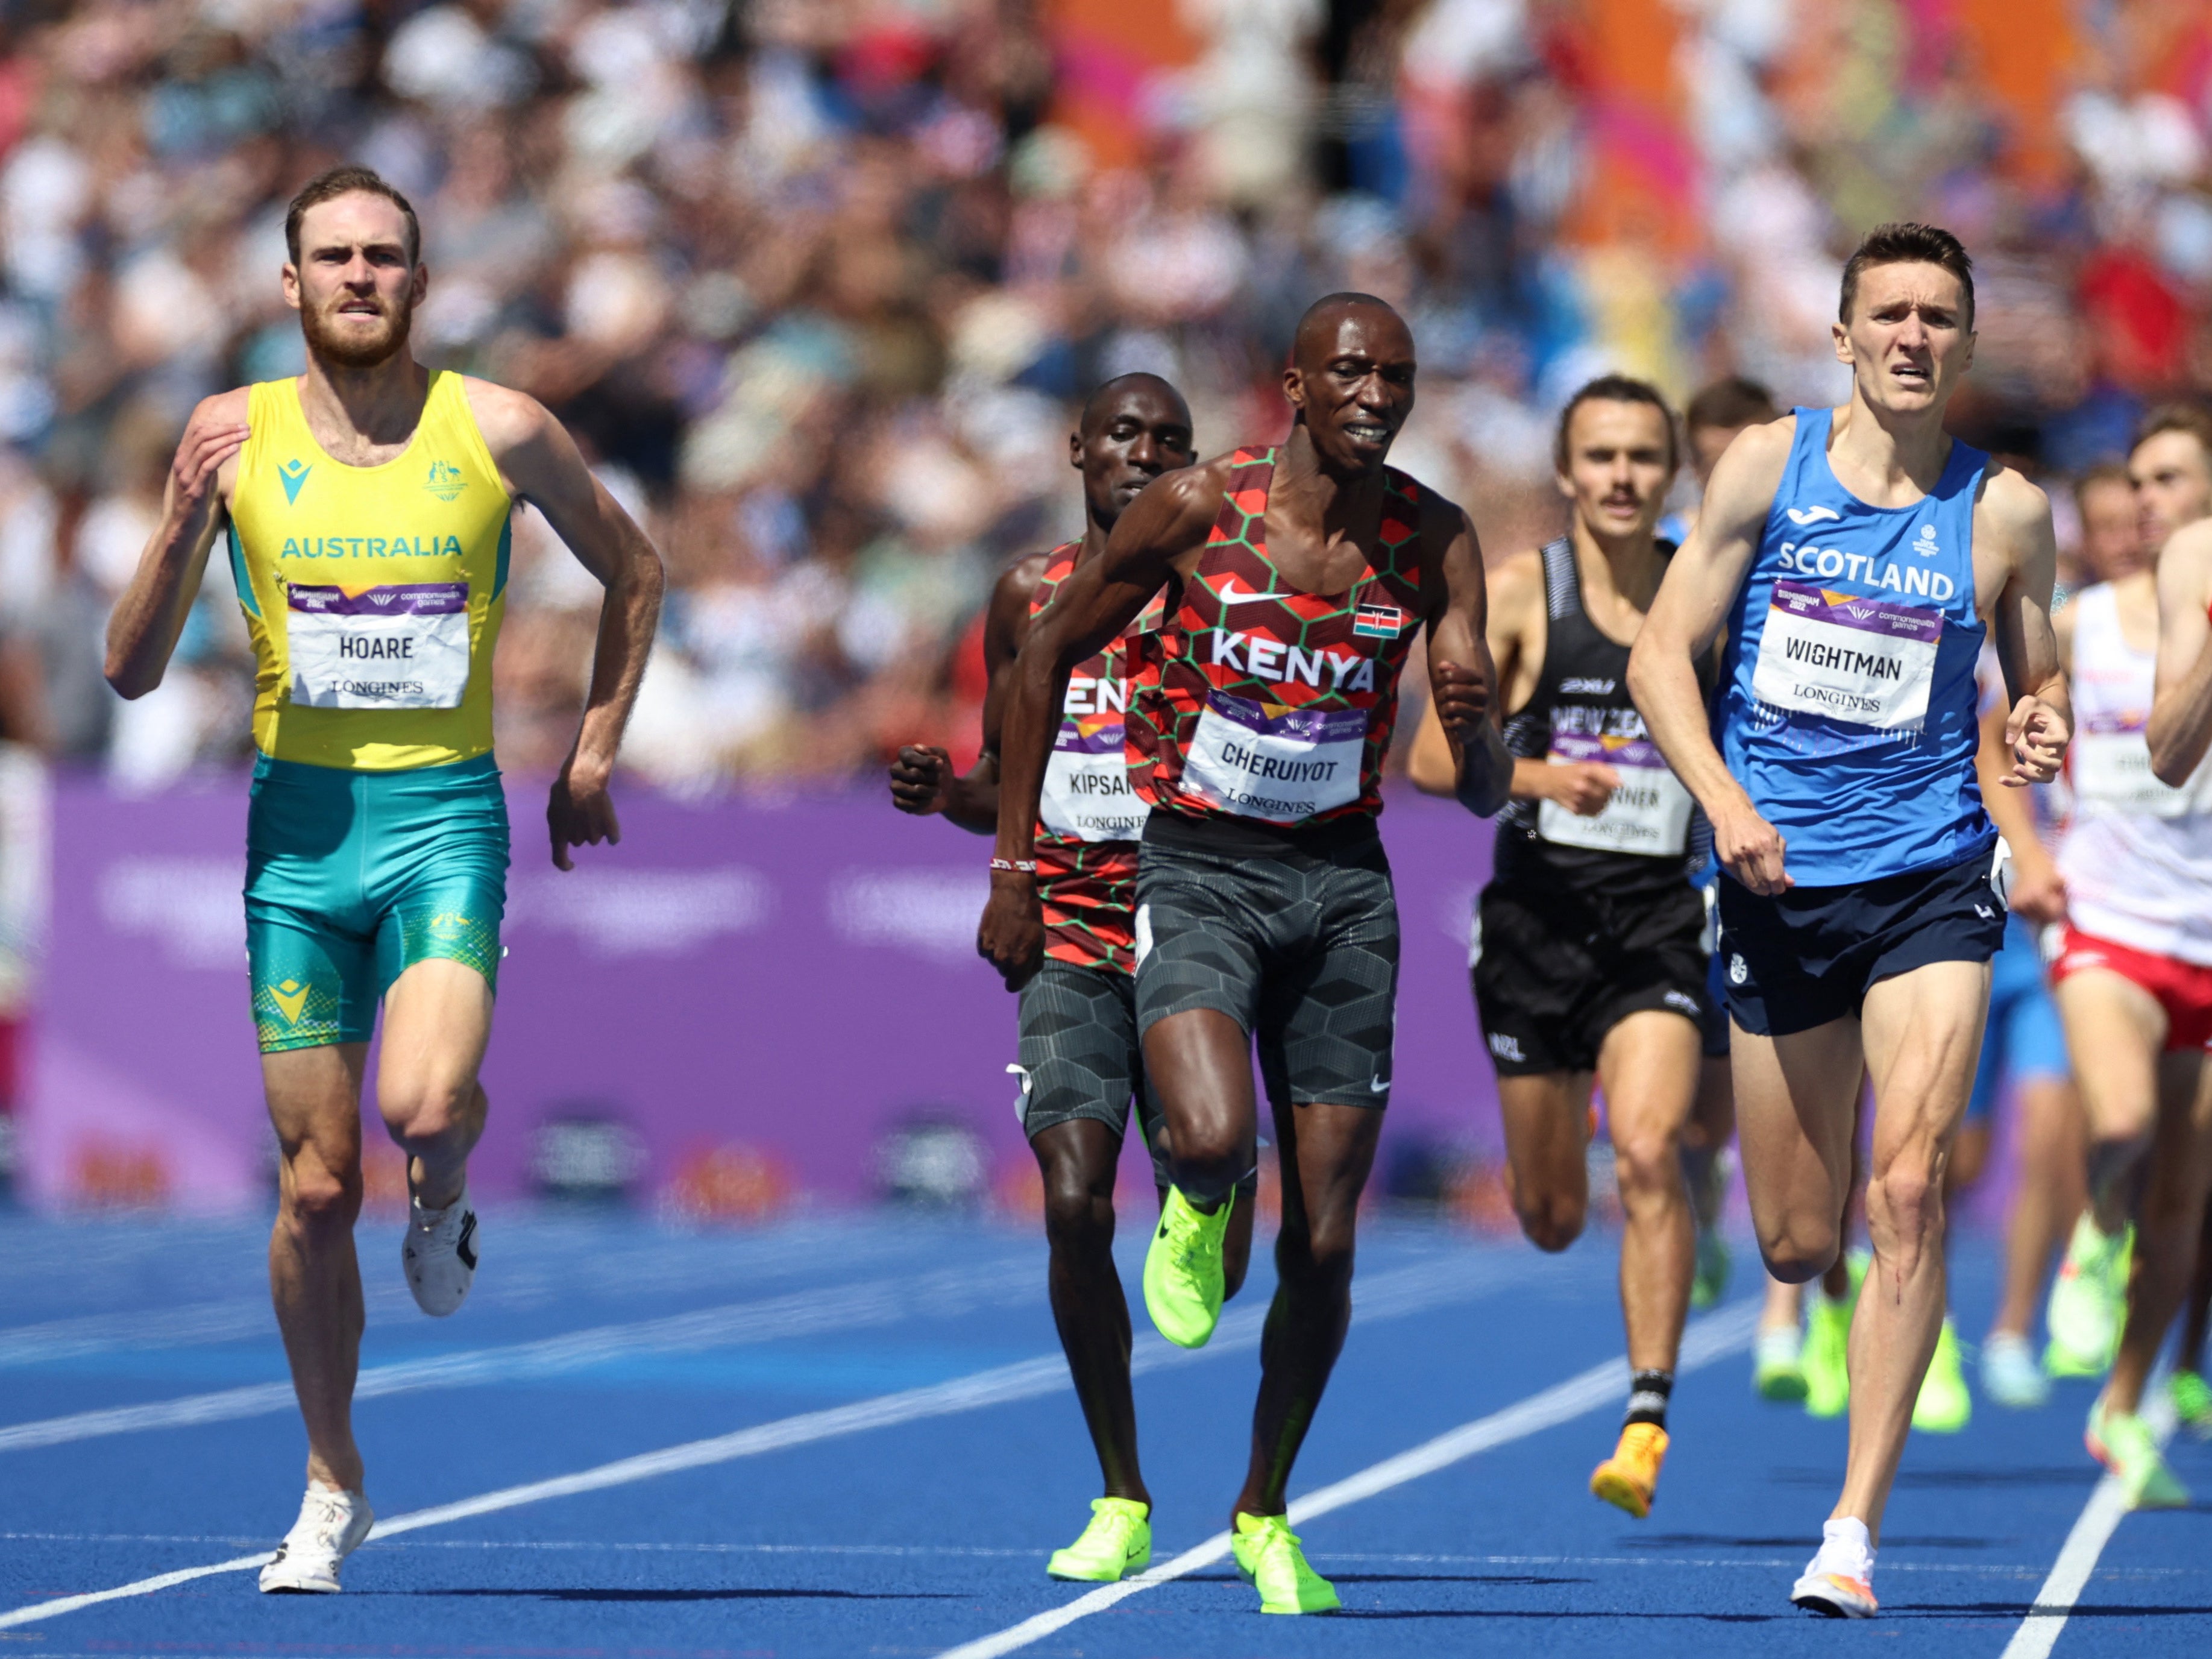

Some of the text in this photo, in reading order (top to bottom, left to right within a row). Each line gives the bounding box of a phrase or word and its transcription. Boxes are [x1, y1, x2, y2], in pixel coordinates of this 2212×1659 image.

[281, 535, 463, 558] AUSTRALIA
[1778, 542, 1954, 601] SCOTLAND
[400, 591, 459, 600] commonwealth
[417, 599, 445, 608] games
[1777, 590, 1820, 606] BIRMINGHAM
[1789, 600, 1806, 611] 2022
[1879, 612, 1935, 628] commonwealth
[1891, 621, 1918, 631] games
[340, 637, 413, 658] HOARE
[1211, 627, 1374, 693] KENYA
[1786, 637, 1902, 680] WIGHTMAN
[331, 681, 424, 694] LONGINES
[1794, 684, 1881, 713] LONGINES
[1227, 707, 1246, 720] 2022
[1549, 705, 1607, 736] NEW
[1330, 727, 1352, 736] games
[1222, 743, 1338, 782] CHERUIYOT
[1226, 787, 1315, 814] LONGINES
